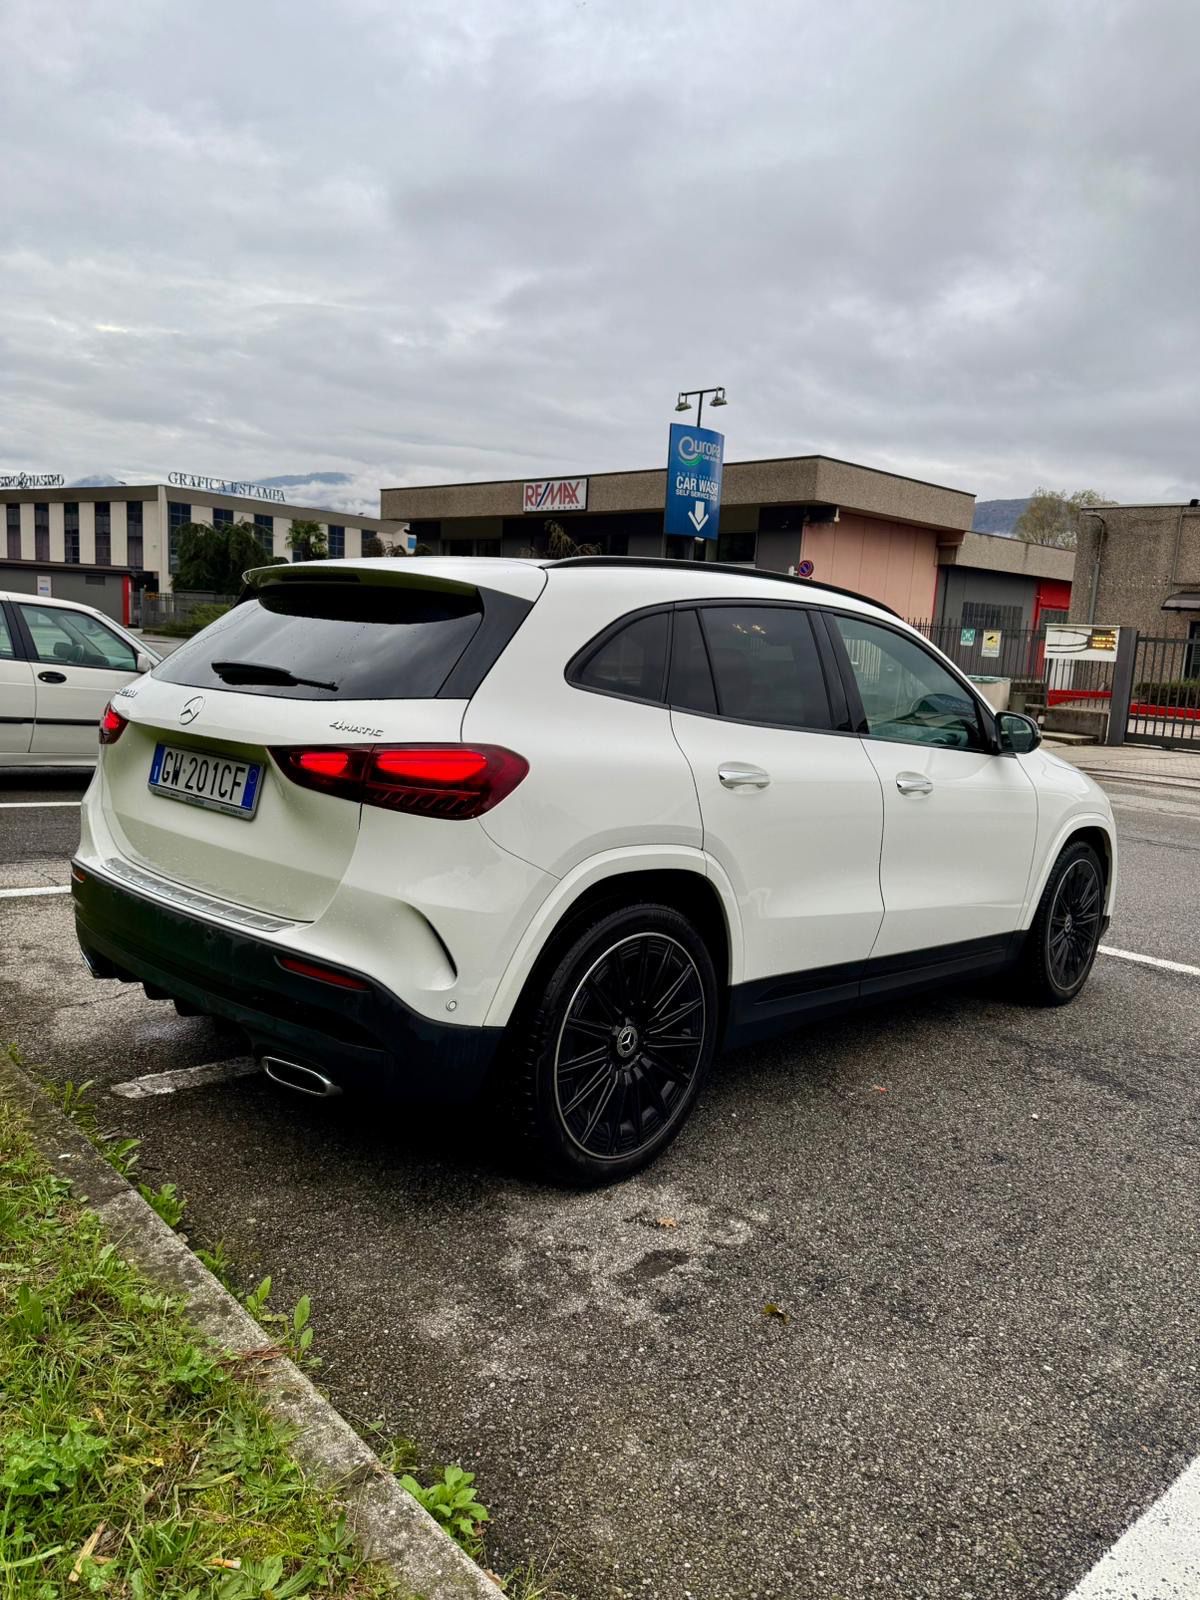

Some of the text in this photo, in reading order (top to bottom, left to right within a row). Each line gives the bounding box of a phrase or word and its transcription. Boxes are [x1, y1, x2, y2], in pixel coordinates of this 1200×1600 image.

[167, 471, 227, 492] GRAFICA
[676, 475, 697, 490] CAR
[699, 480, 719, 495] WASH
[525, 481, 580, 508] RE/MAX
[675, 488, 690, 496] SELF
[329, 720, 384, 737] 4MATIC
